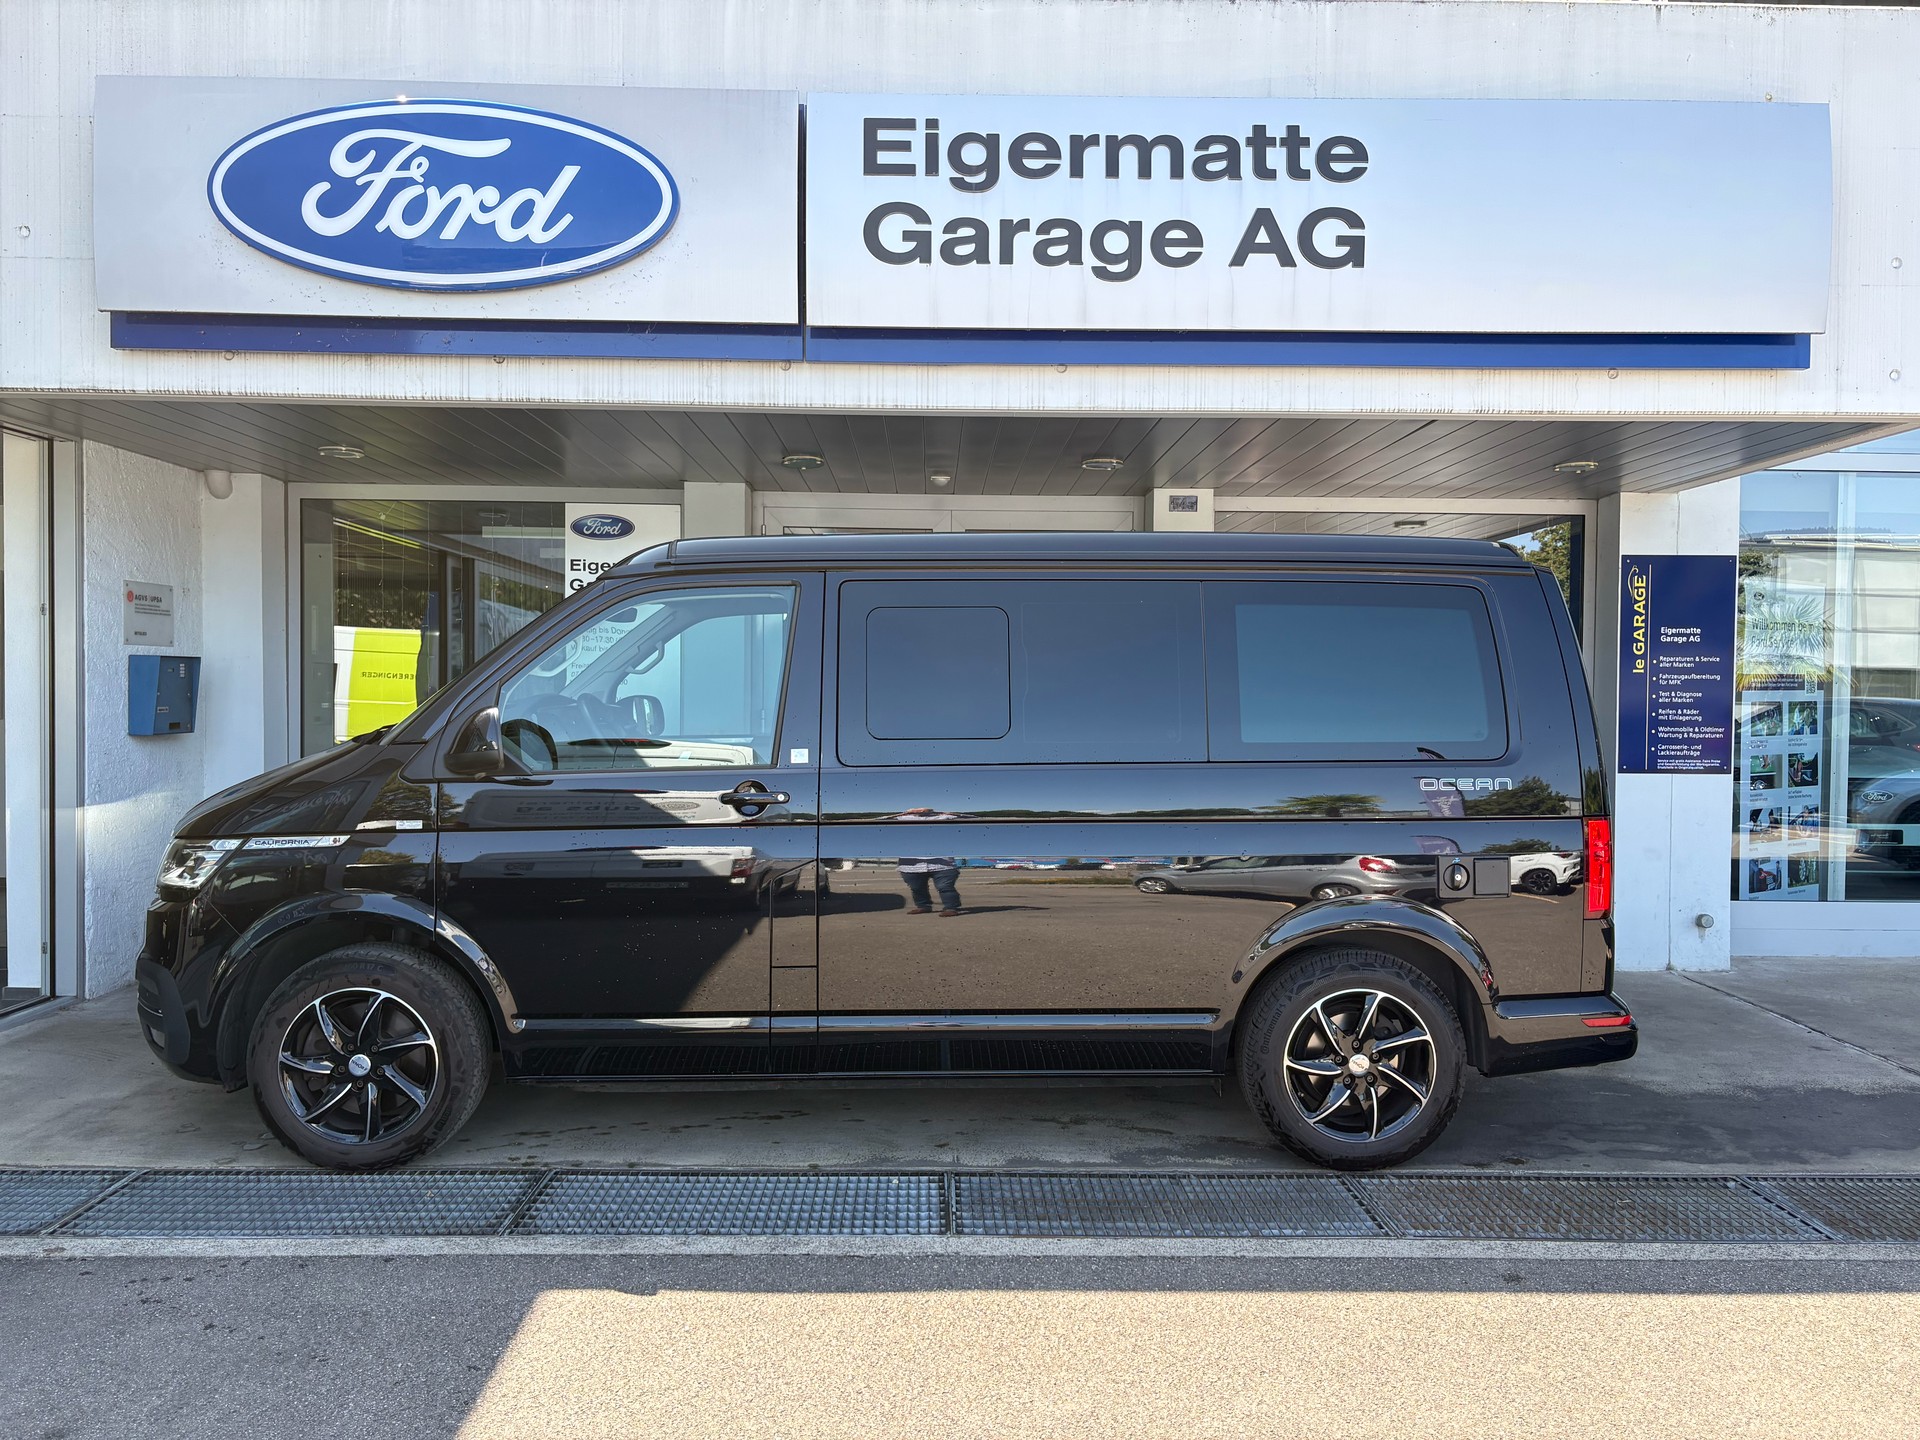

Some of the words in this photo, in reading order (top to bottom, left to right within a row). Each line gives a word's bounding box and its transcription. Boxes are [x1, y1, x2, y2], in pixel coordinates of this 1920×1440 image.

[863, 117, 1369, 194] Eigermatte
[301, 128, 582, 244] Ford
[863, 201, 1204, 282] Garage
[1228, 207, 1366, 269] AG
[583, 517, 622, 535] Ford
[570, 578, 596, 591] G
[1633, 574, 1646, 655] GARAGE
[1660, 626, 1702, 635] Eigermatte
[1660, 635, 1688, 643] Garage
[1632, 658, 1645, 675] le
[1659, 673, 1721, 681] Fahrzeugaufbereitung
[1419, 777, 1513, 791] OCEAN
[1260, 1007, 1283, 1055] Continental
